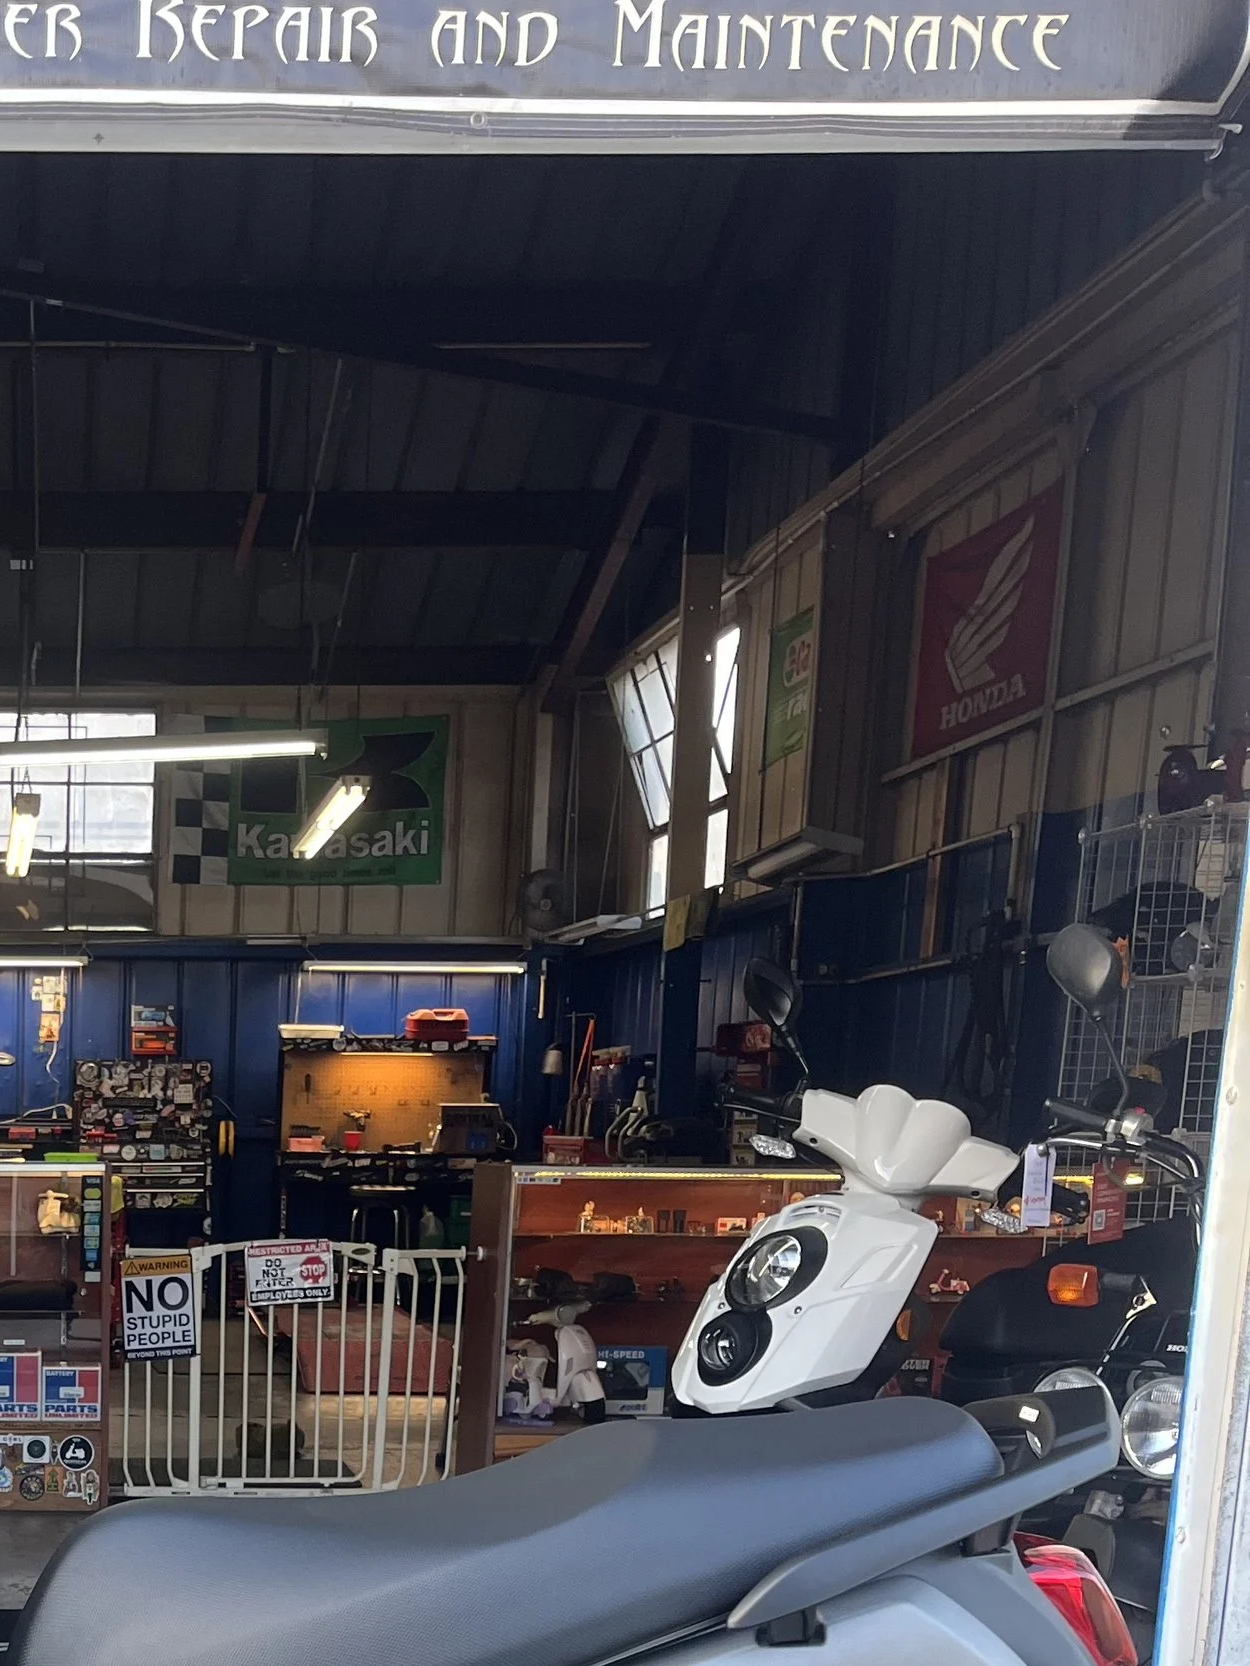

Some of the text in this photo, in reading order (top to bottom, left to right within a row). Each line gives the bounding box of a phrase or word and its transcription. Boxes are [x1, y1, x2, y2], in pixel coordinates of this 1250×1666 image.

[135, 0, 379, 67] REPAIR
[430, 9, 558, 68] AND
[611, 0, 1070, 73] MAINTENANCE
[938, 673, 1027, 731] HONDA
[236, 819, 430, 860] Kaasaki
[249, 1244, 303, 1256] RESTRICTED
[138, 1260, 189, 1273] WARNING
[265, 1258, 282, 1268] DO
[262, 1267, 287, 1279] NOT
[301, 1264, 326, 1277] STOP
[125, 1276, 190, 1314] NO
[251, 1289, 305, 1301] EMPLOYEES
[126, 1313, 191, 1332] STUPID
[126, 1329, 193, 1347] PEOPLE
[127, 1350, 156, 1359] BEYOND
[172, 1347, 192, 1356] POINT
[598, 1350, 646, 1359] HI-SPEED
[44, 1404, 98, 1414] PARTS
